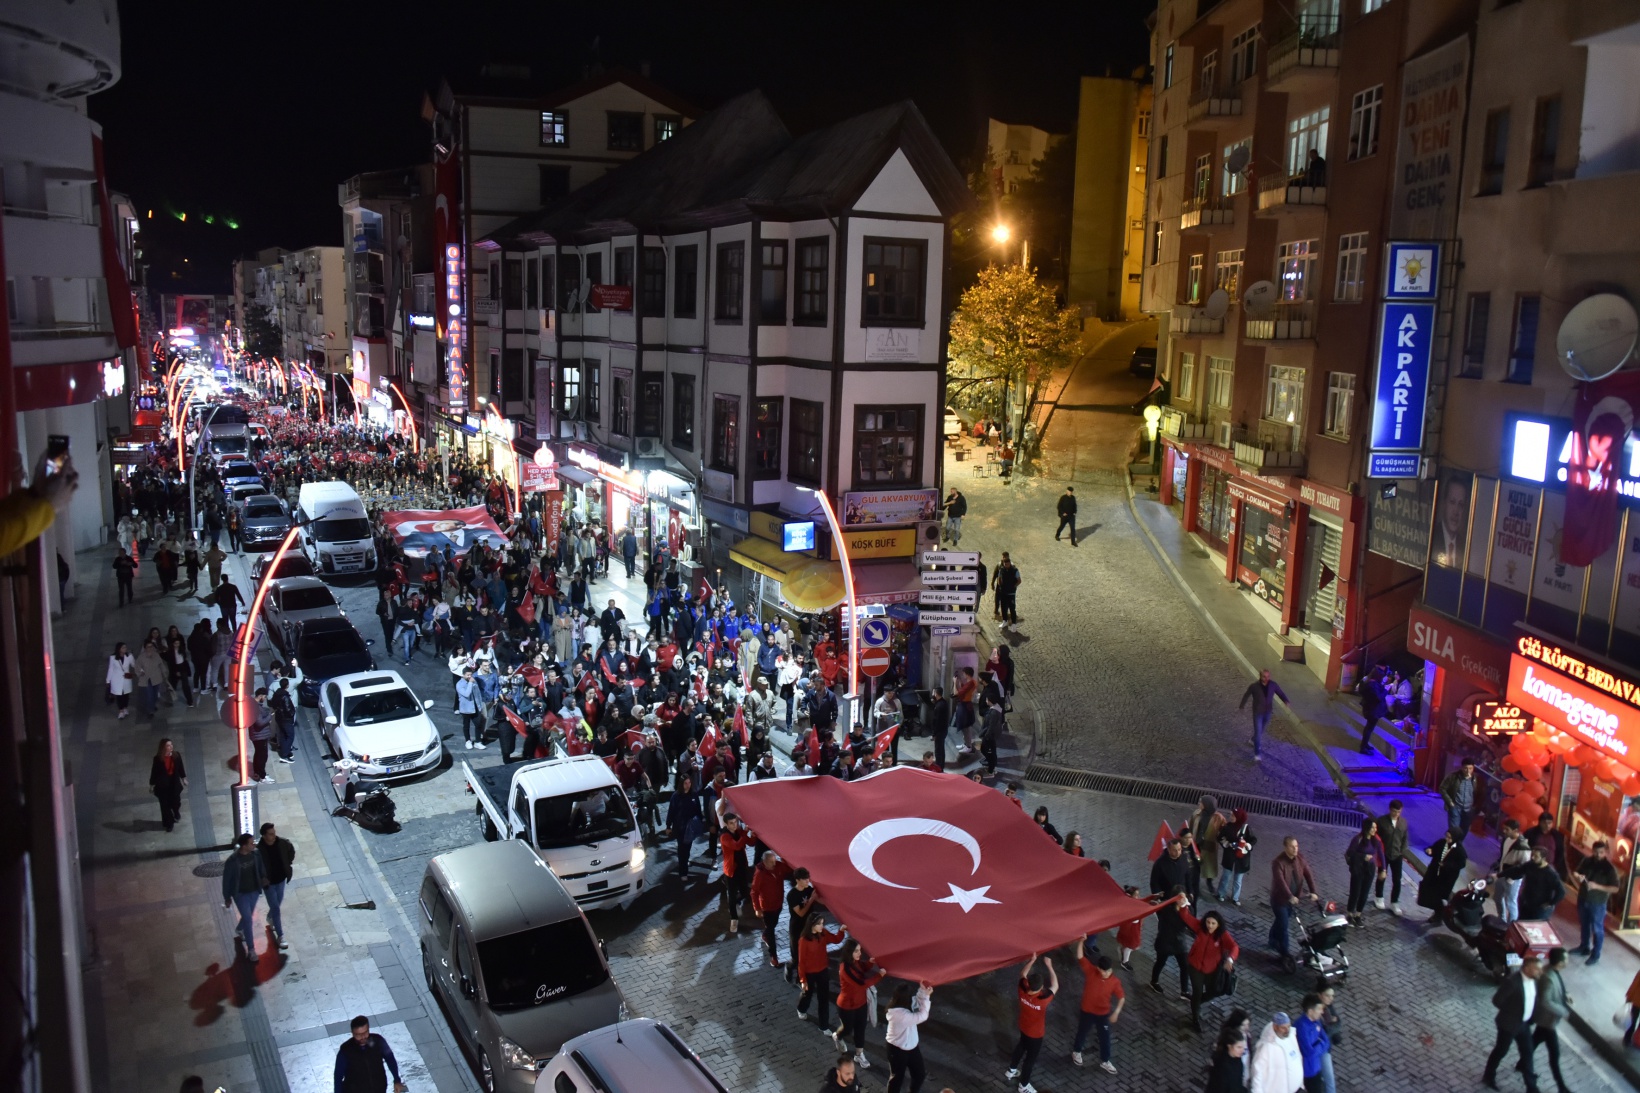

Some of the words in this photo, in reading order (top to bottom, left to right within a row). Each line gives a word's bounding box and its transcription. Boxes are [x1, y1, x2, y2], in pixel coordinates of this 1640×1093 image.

[1410, 120, 1451, 156] YENİ
[1407, 181, 1446, 211] GENÇ
[447, 246, 459, 300] OTEL
[1397, 313, 1418, 348] AK
[449, 319, 462, 398] ATALAY
[1393, 352, 1413, 440] PARTİ
[1375, 458, 1415, 467] GÜMÜŞHANE
[1381, 466, 1414, 474] BAŞKANLIĞI
[861, 494, 879, 504] GÜL
[880, 493, 927, 504] AKVARYUM
[1246, 493, 1270, 510] LOKMAN
[1508, 489, 1534, 509] KUTLU
[1502, 516, 1532, 539] GÜÇLÜ
[851, 539, 872, 552] KÖŞK
[875, 537, 897, 549] BÜFE
[1496, 531, 1534, 557] TÜRKİYE
[921, 614, 957, 622] Kütüphane
[1413, 621, 1456, 662] SILA
[1492, 705, 1521, 719] ALO
[1521, 665, 1619, 736] komagene
[1483, 718, 1527, 731] PAKET
